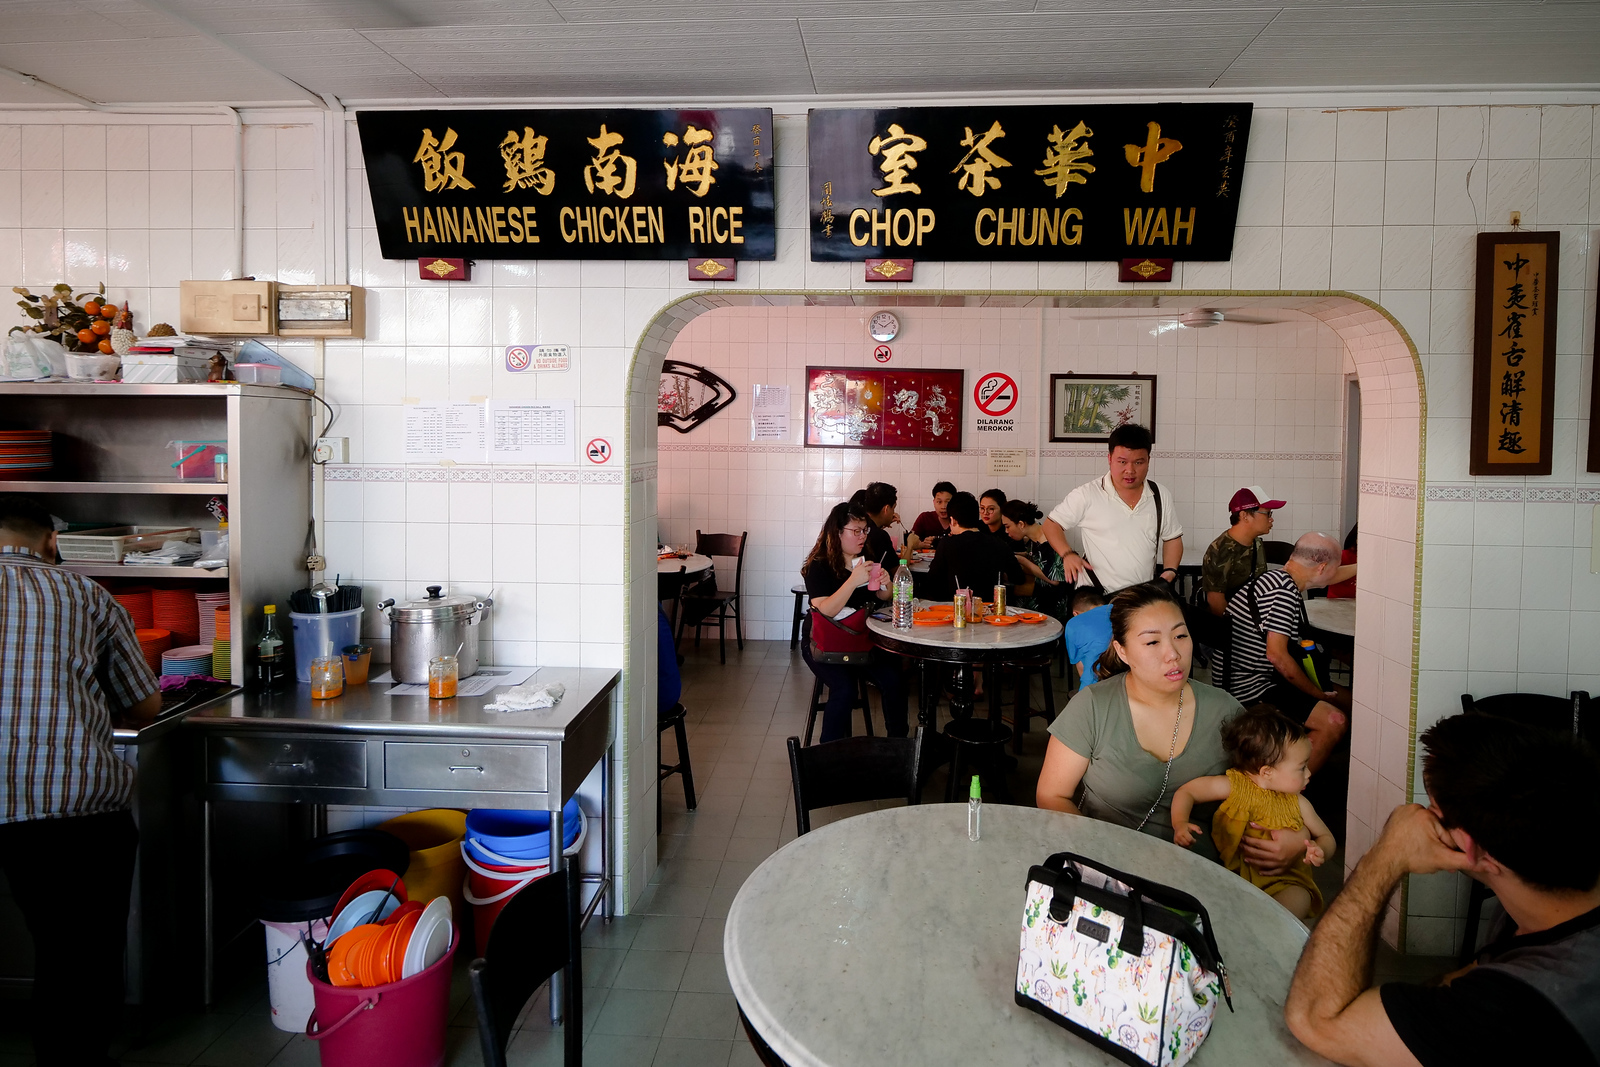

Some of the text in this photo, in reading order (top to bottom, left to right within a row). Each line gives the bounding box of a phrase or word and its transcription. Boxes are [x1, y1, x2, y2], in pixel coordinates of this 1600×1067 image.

[868, 120, 1183, 199] 中華茶室
[402, 205, 745, 244] HAINANESE CHICKEN RICE
[848, 207, 1196, 247] CHOP CHUNG WAH
